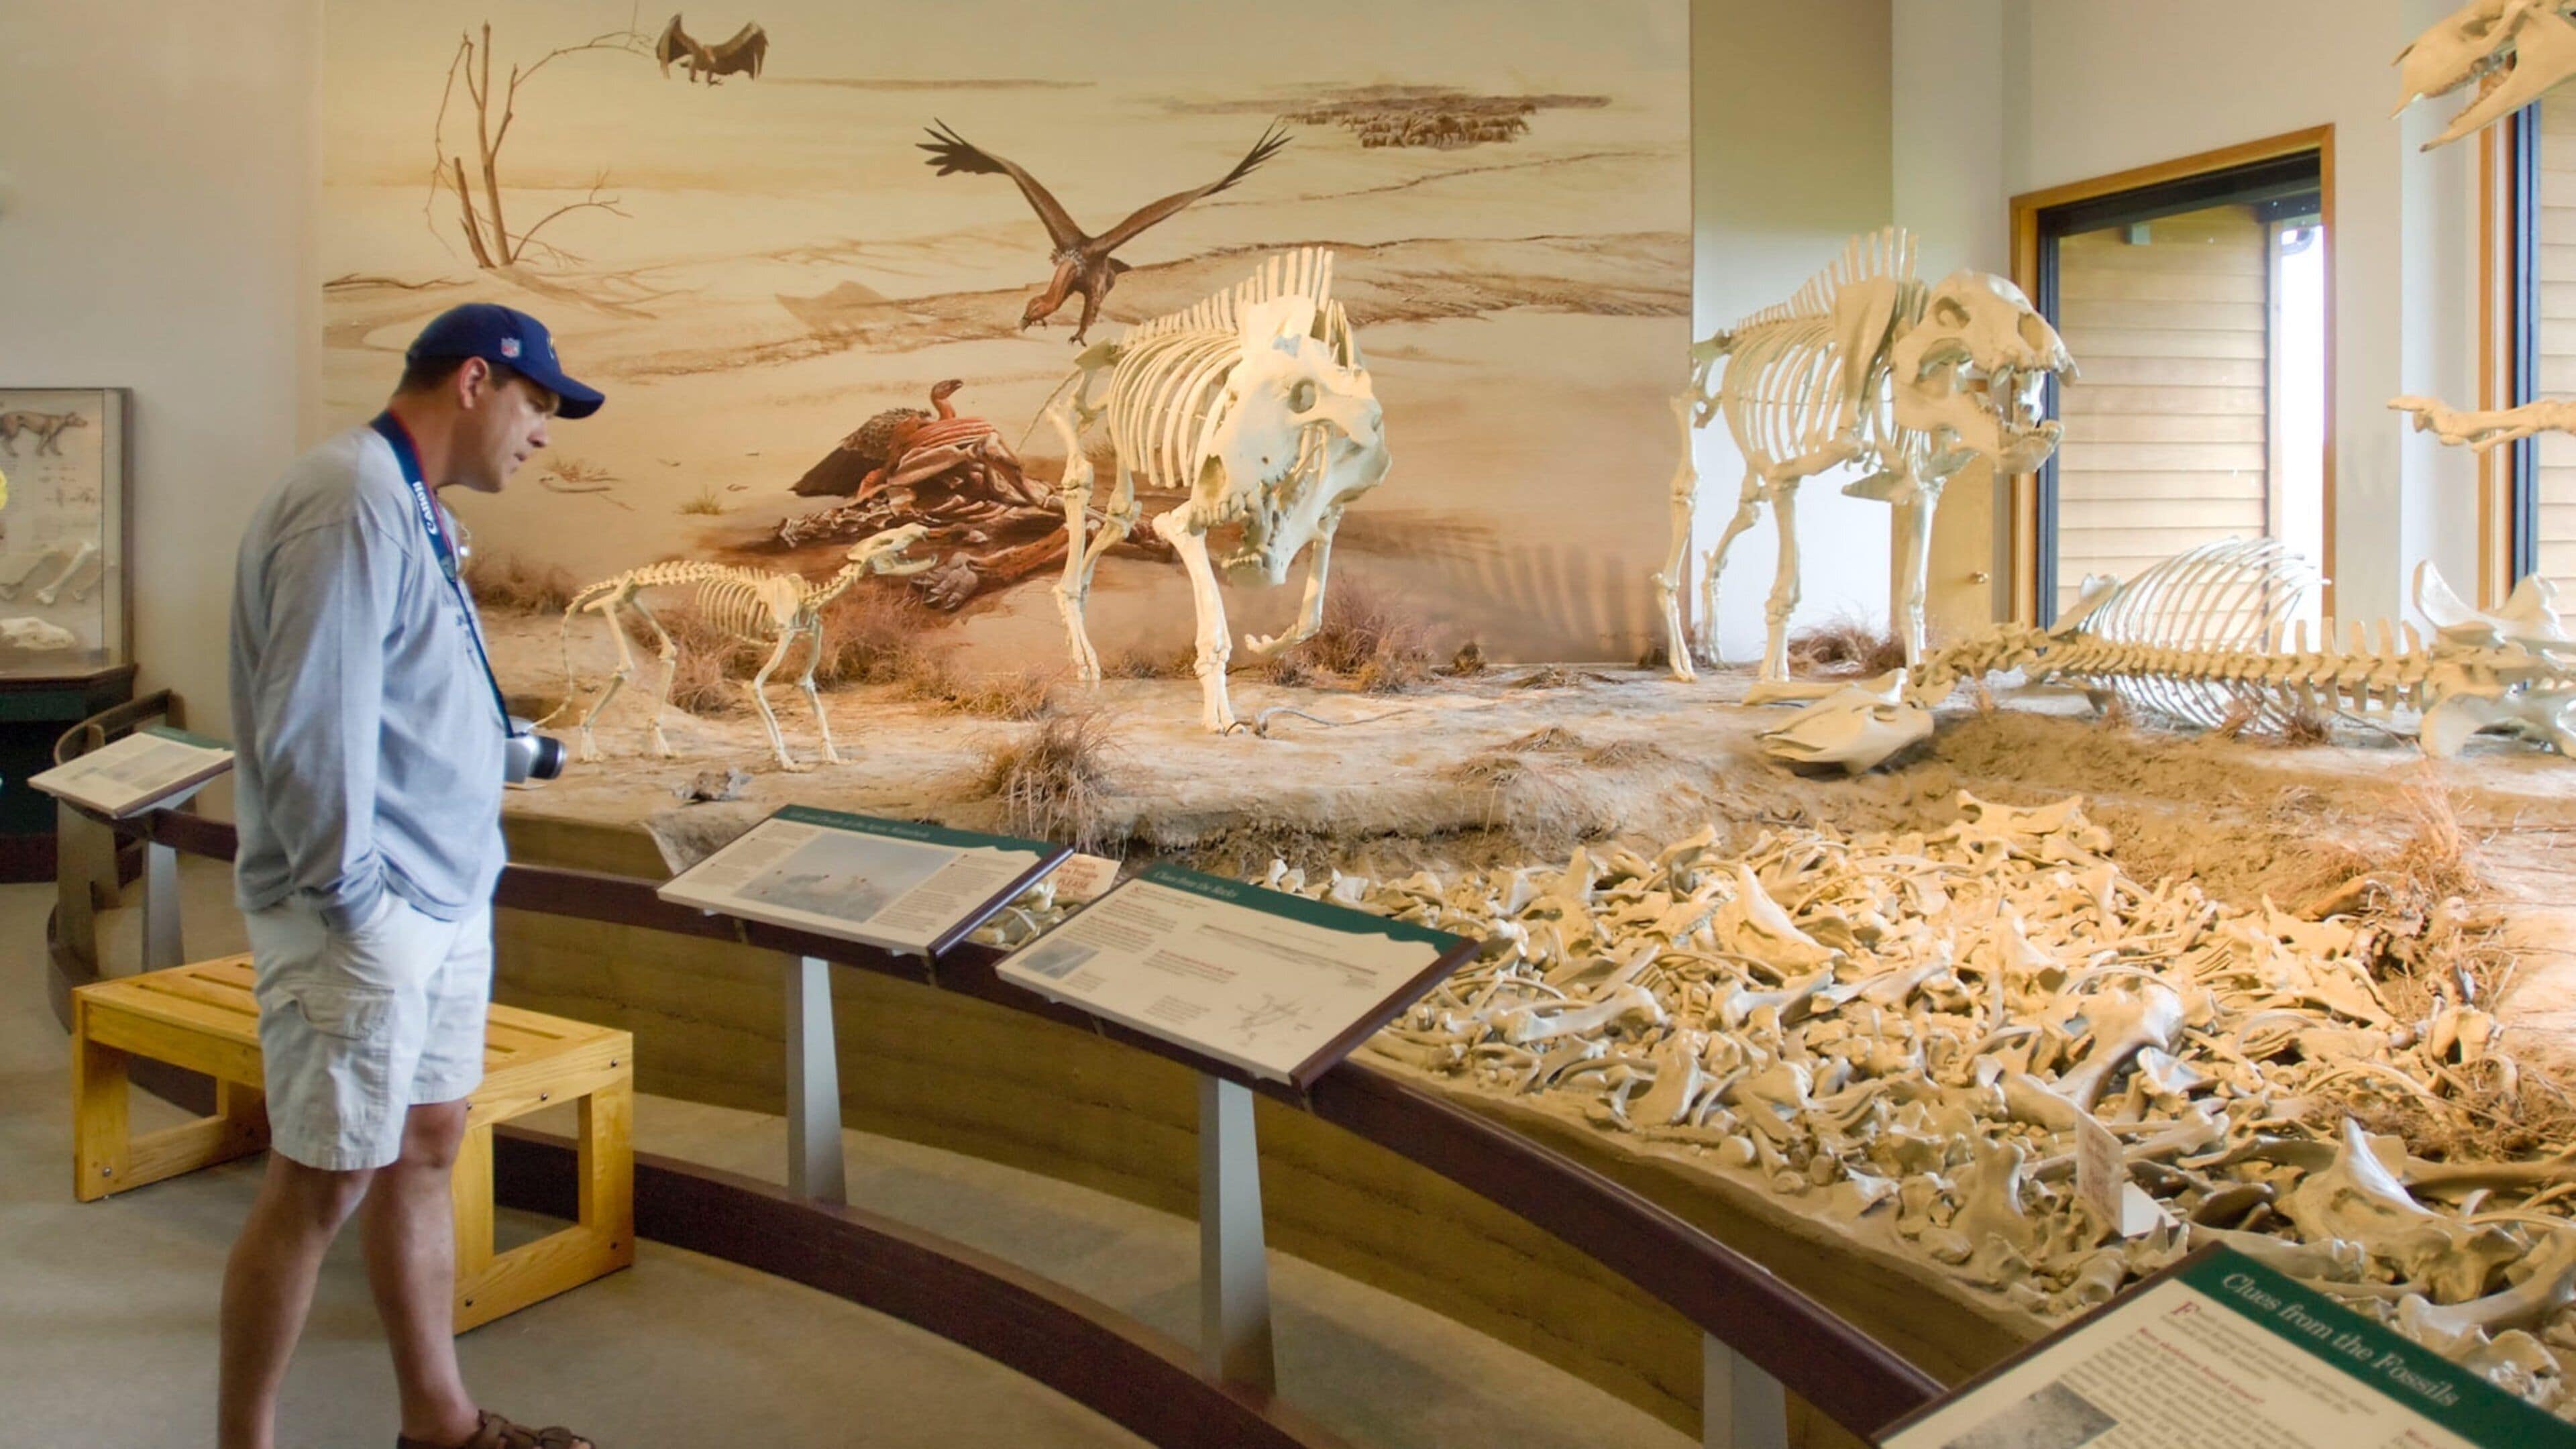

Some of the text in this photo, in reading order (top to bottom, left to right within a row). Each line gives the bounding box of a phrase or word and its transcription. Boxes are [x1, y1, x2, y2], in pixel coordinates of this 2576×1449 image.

[412, 480, 438, 536] Canon
[2222, 1273, 2461, 1407] Clues from the Fossils
